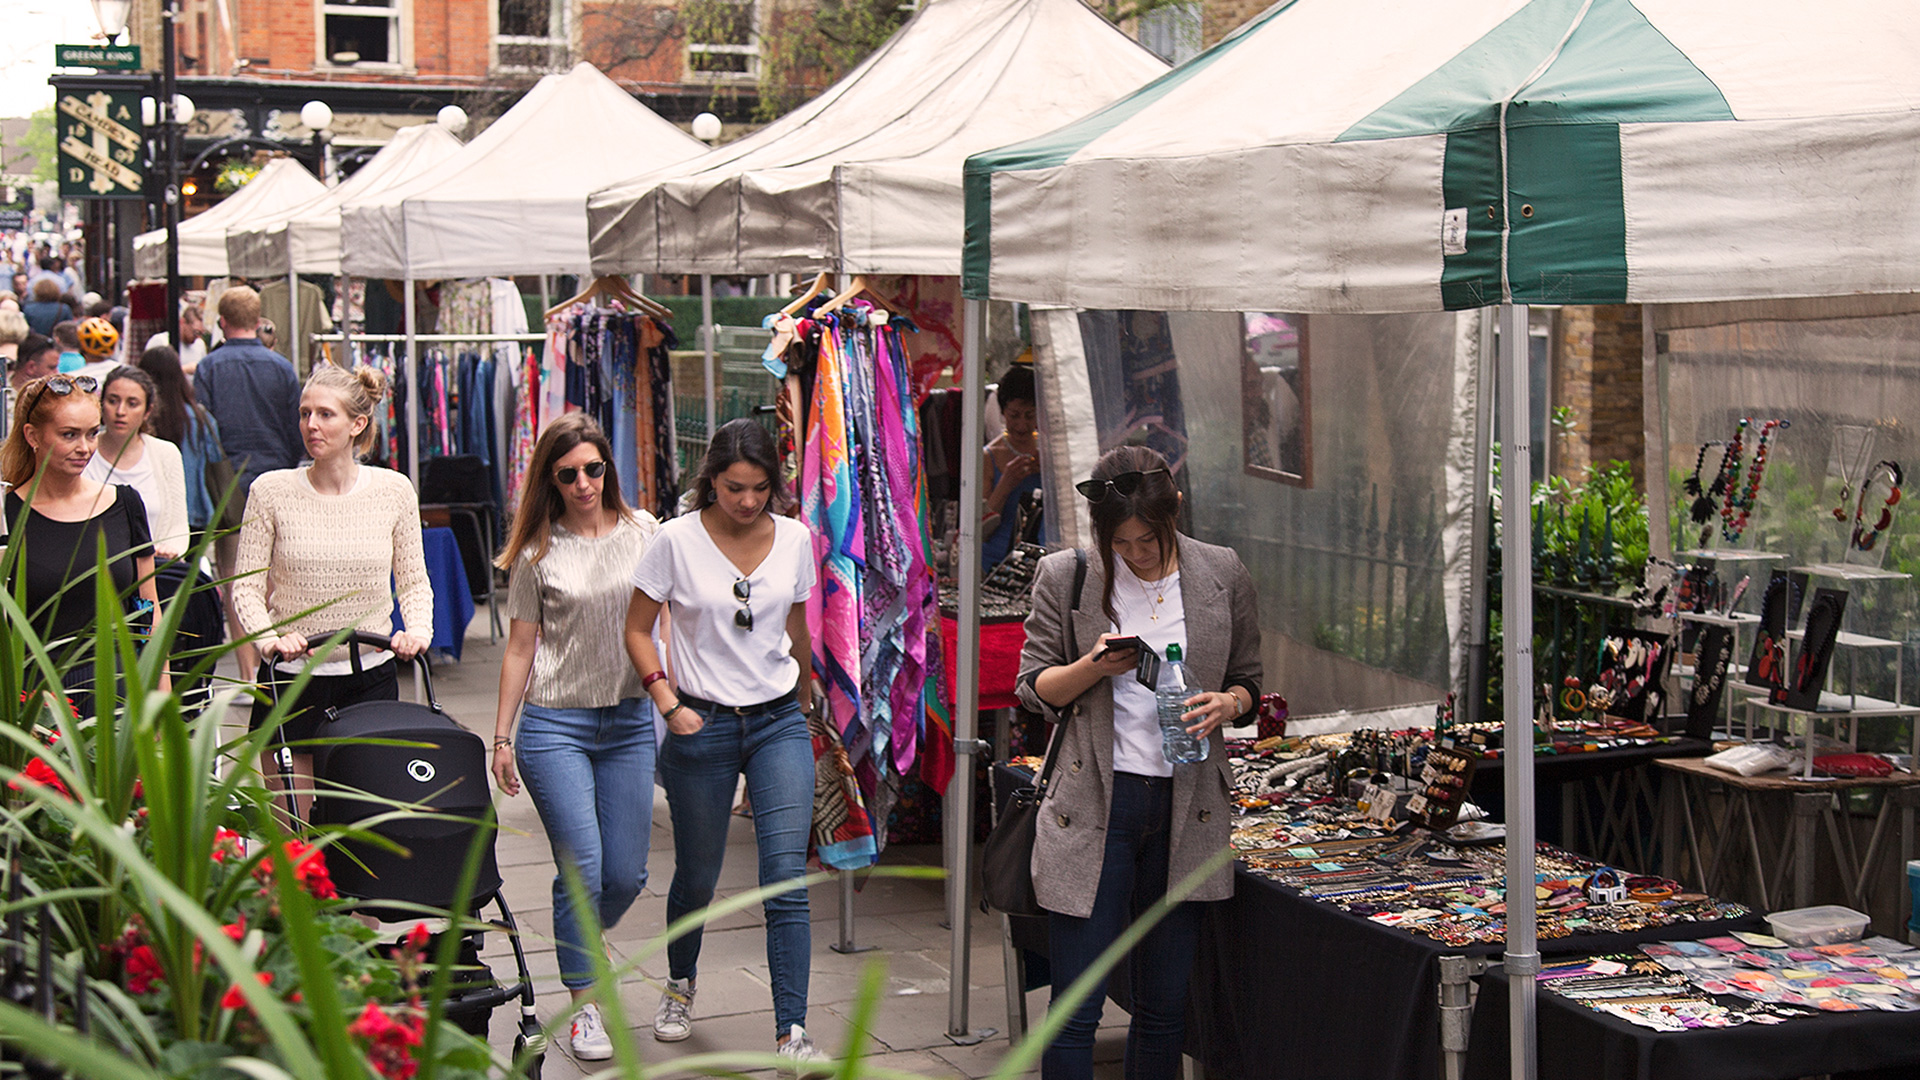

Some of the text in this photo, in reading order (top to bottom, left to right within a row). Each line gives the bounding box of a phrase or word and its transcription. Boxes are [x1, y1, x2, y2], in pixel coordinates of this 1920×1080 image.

[62, 50, 134, 62] GREENE KING
[116, 105, 131, 120] A
[75, 104, 126, 140] CAMDEN
[85, 151, 120, 177] HEAD
[69, 167, 84, 183] D
